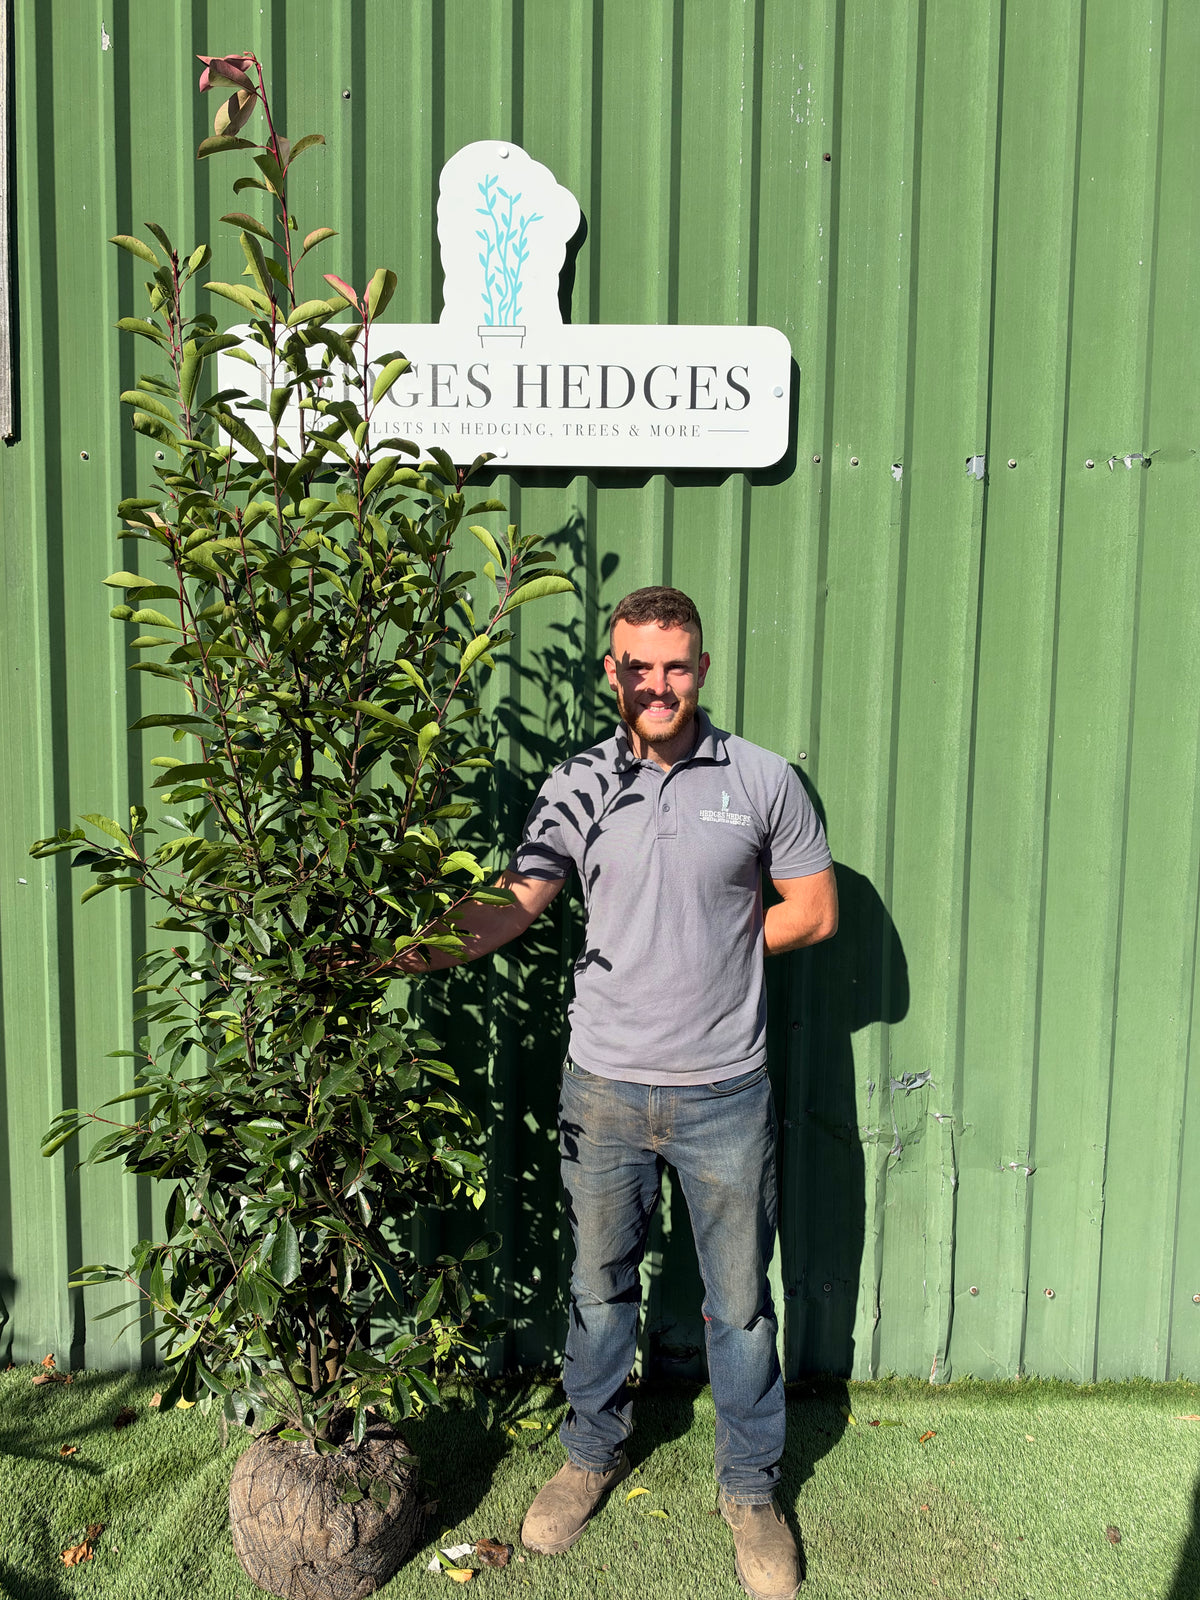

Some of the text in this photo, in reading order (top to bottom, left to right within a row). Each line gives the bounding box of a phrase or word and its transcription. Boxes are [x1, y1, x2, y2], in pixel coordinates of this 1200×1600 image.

[512, 364, 750, 410] HEDGES
[433, 422, 451, 434] IN
[461, 422, 553, 437] HEDGING,
[562, 423, 620, 437] TREES
[628, 424, 640, 437] &
[650, 424, 701, 437] MORE
